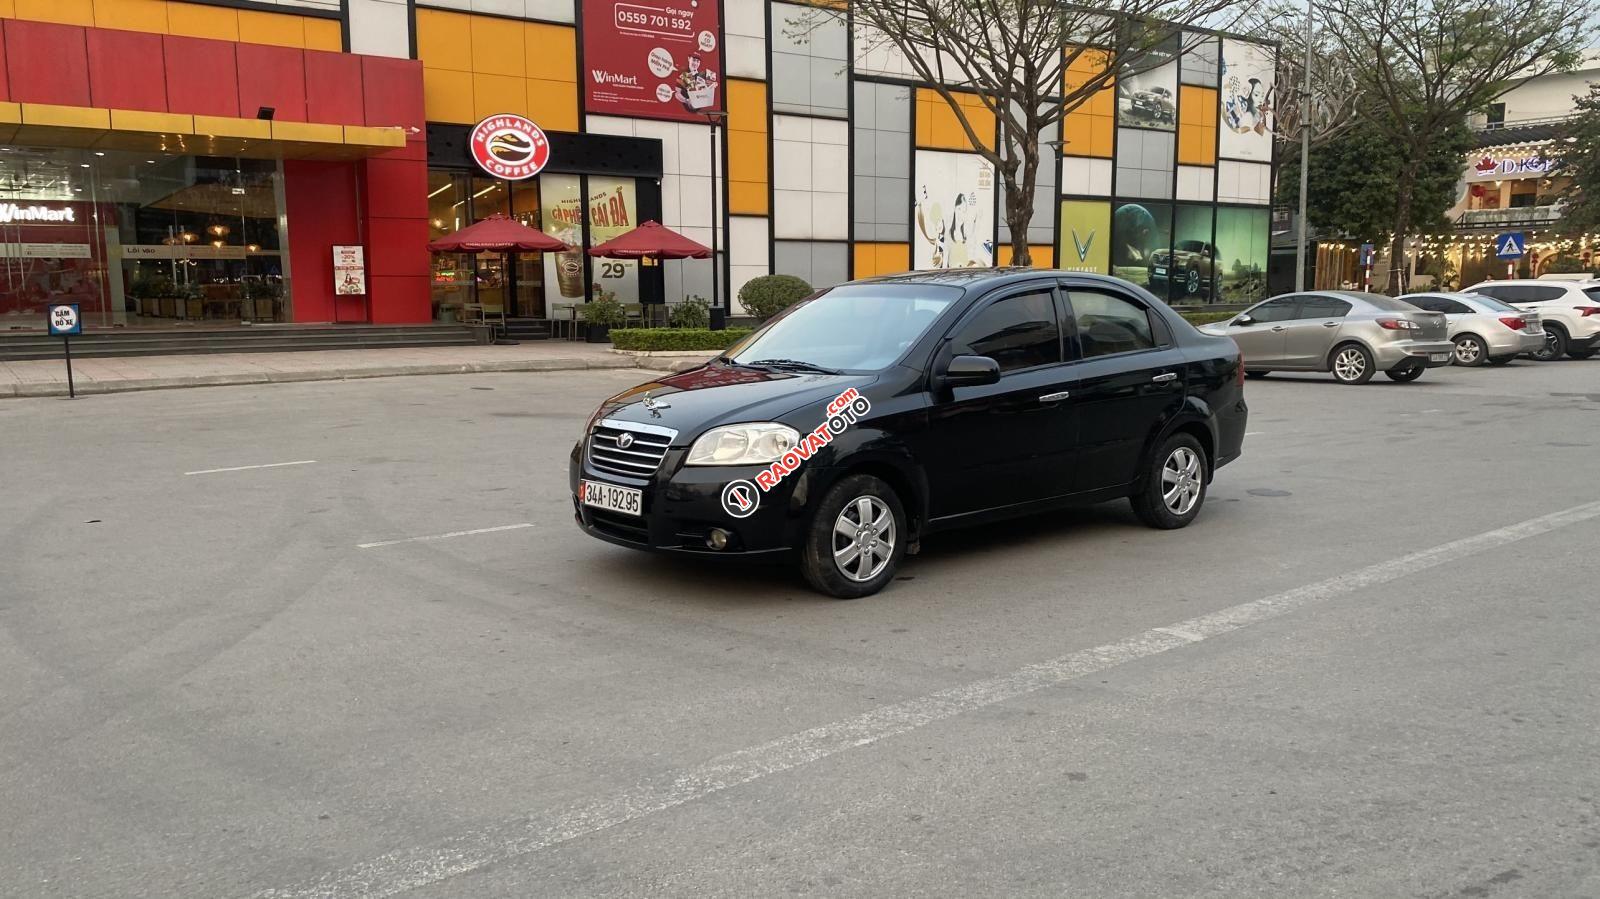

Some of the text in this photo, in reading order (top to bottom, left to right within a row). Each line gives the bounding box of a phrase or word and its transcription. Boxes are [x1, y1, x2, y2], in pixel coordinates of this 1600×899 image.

[618, 11, 692, 31] 0559 701 592
[678, 9, 694, 19] ngay
[592, 69, 638, 85] WinMart
[476, 118, 545, 146] HIGHLANDS
[485, 159, 538, 176] COFFEE
[0, 202, 75, 222] WinMart
[601, 262, 625, 279] 29
